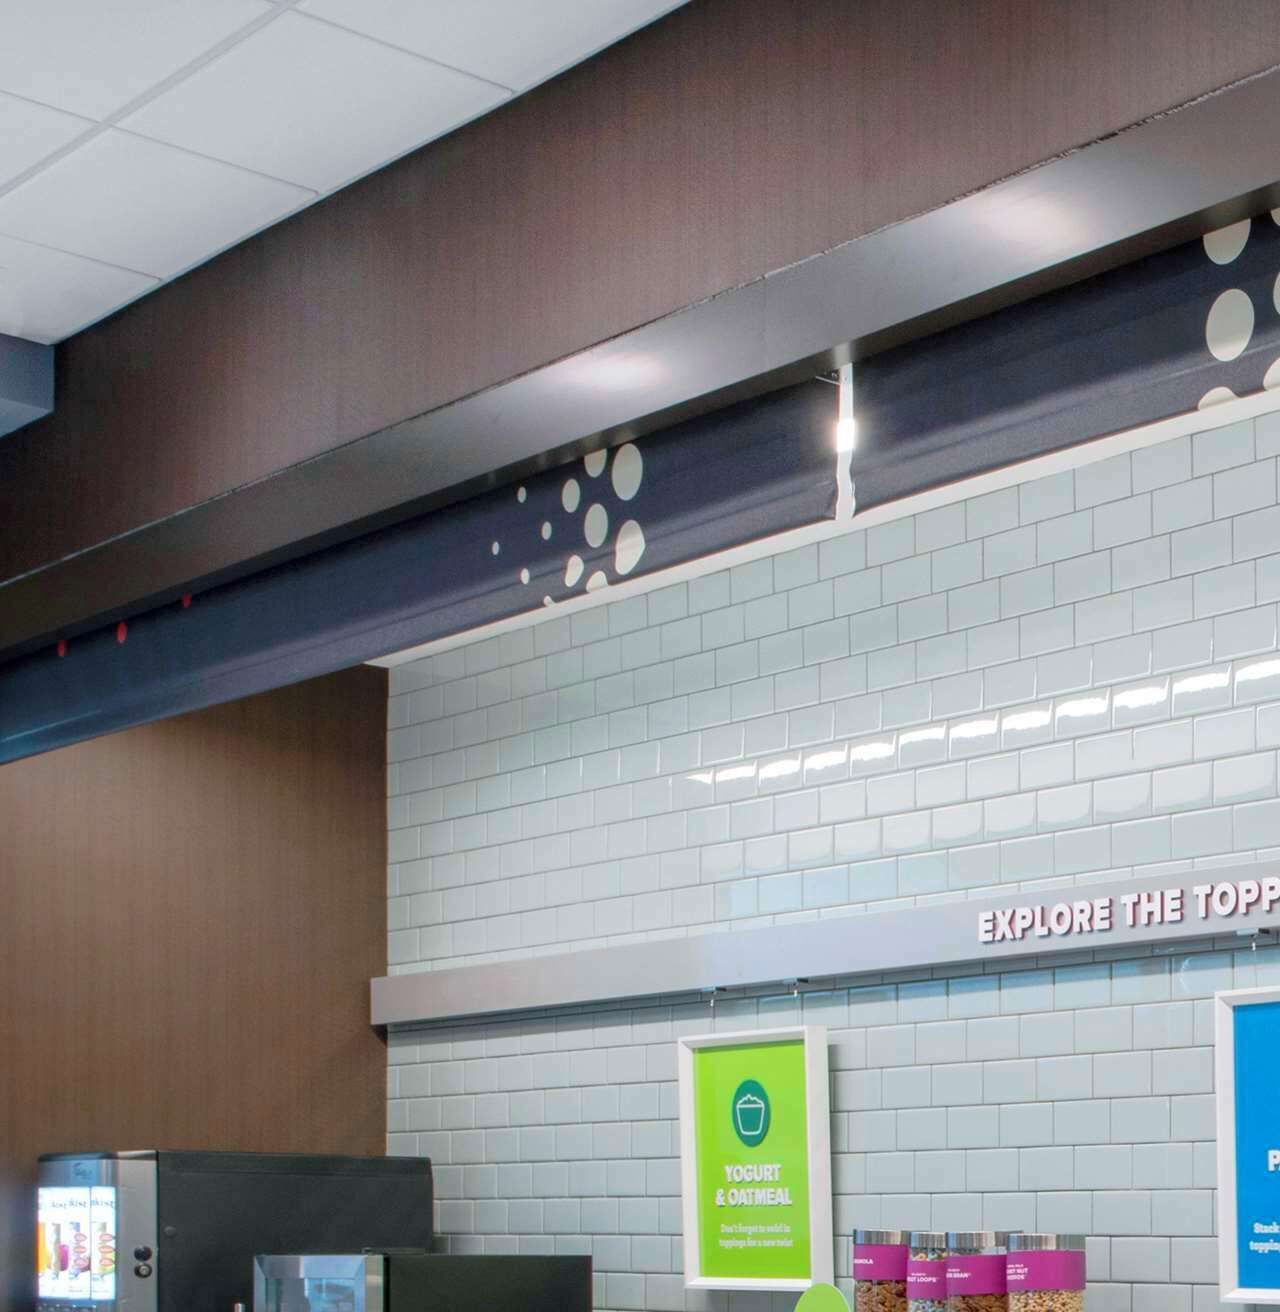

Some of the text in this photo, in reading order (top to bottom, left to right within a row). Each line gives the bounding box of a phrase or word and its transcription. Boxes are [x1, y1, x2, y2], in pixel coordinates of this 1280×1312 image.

[978, 898, 1111, 942] EXPLORE
[1121, 888, 1184, 927] THE
[725, 1164, 782, 1183] YOGURT
[715, 1188, 792, 1207] & OATMEAL
[1254, 1221, 1279, 1233] Stack
